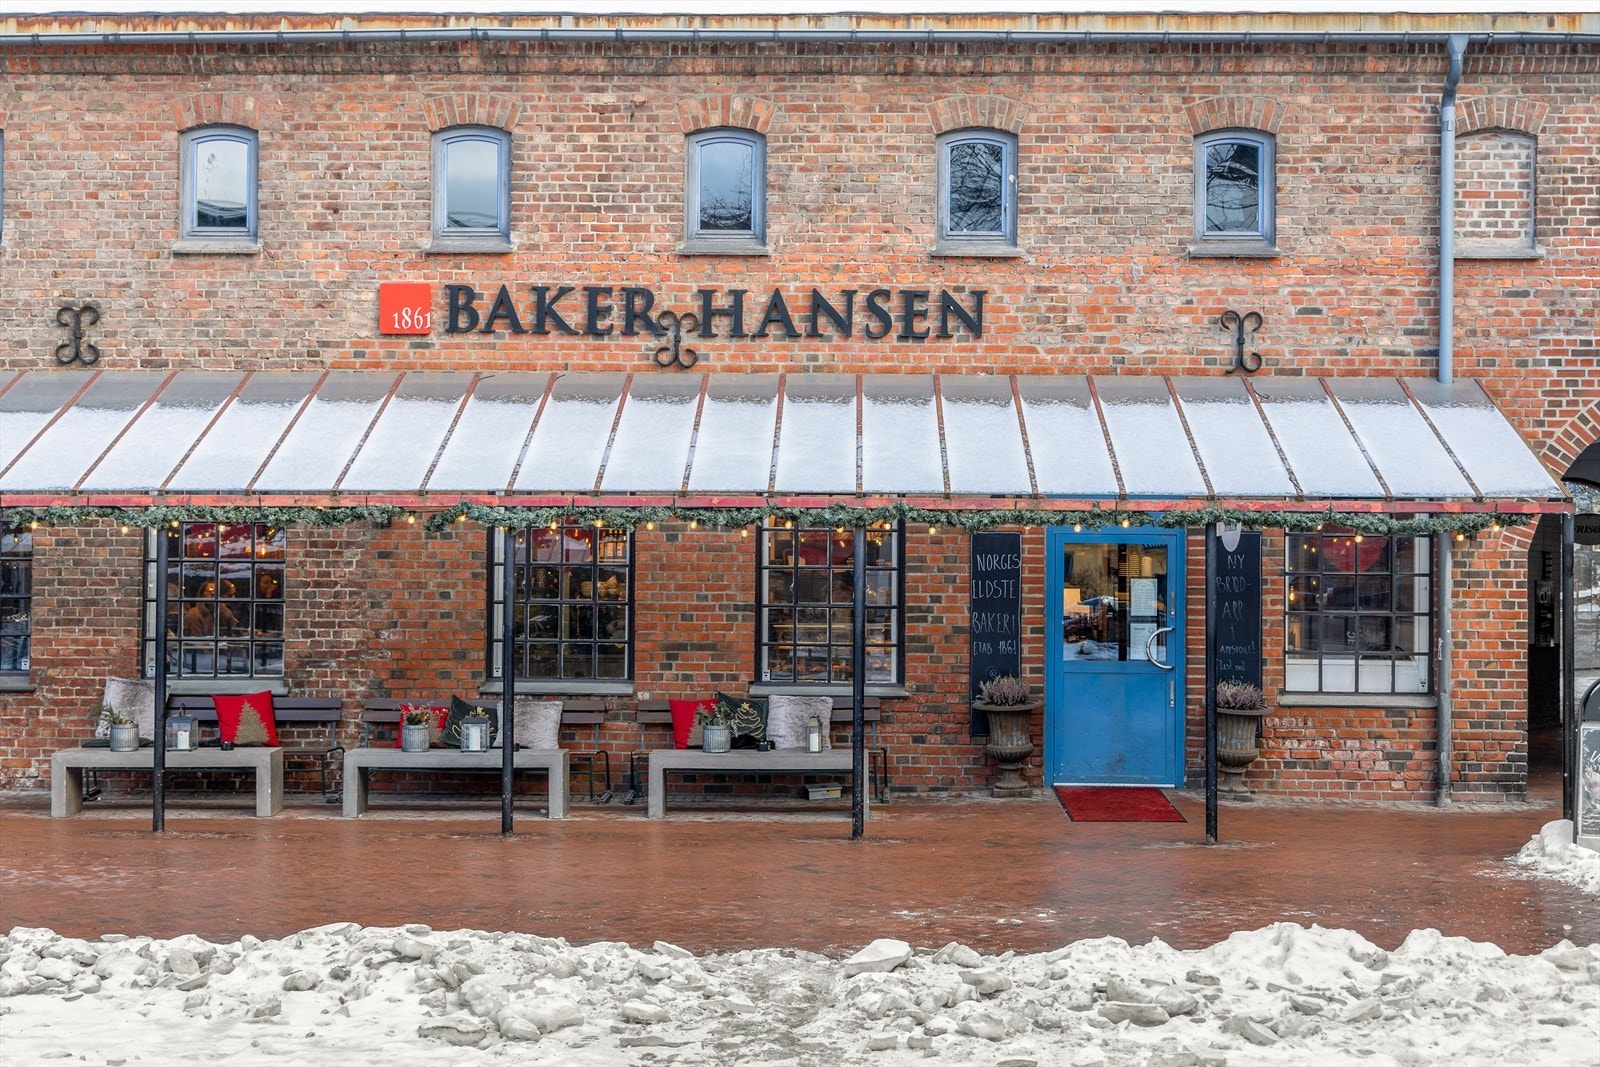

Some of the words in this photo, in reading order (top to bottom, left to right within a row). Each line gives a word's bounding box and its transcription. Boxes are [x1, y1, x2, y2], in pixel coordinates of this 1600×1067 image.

[392, 306, 431, 330] 1861
[445, 284, 668, 336] BAKER
[698, 287, 988, 339] HANSEN
[976, 553, 1021, 572] NORGES
[1227, 554, 1245, 569] NY
[972, 579, 1017, 599] ELDSTE
[1222, 600, 1244, 621] APP
[972, 611, 1015, 635] BAKERI
[973, 641, 993, 656] ETAB
